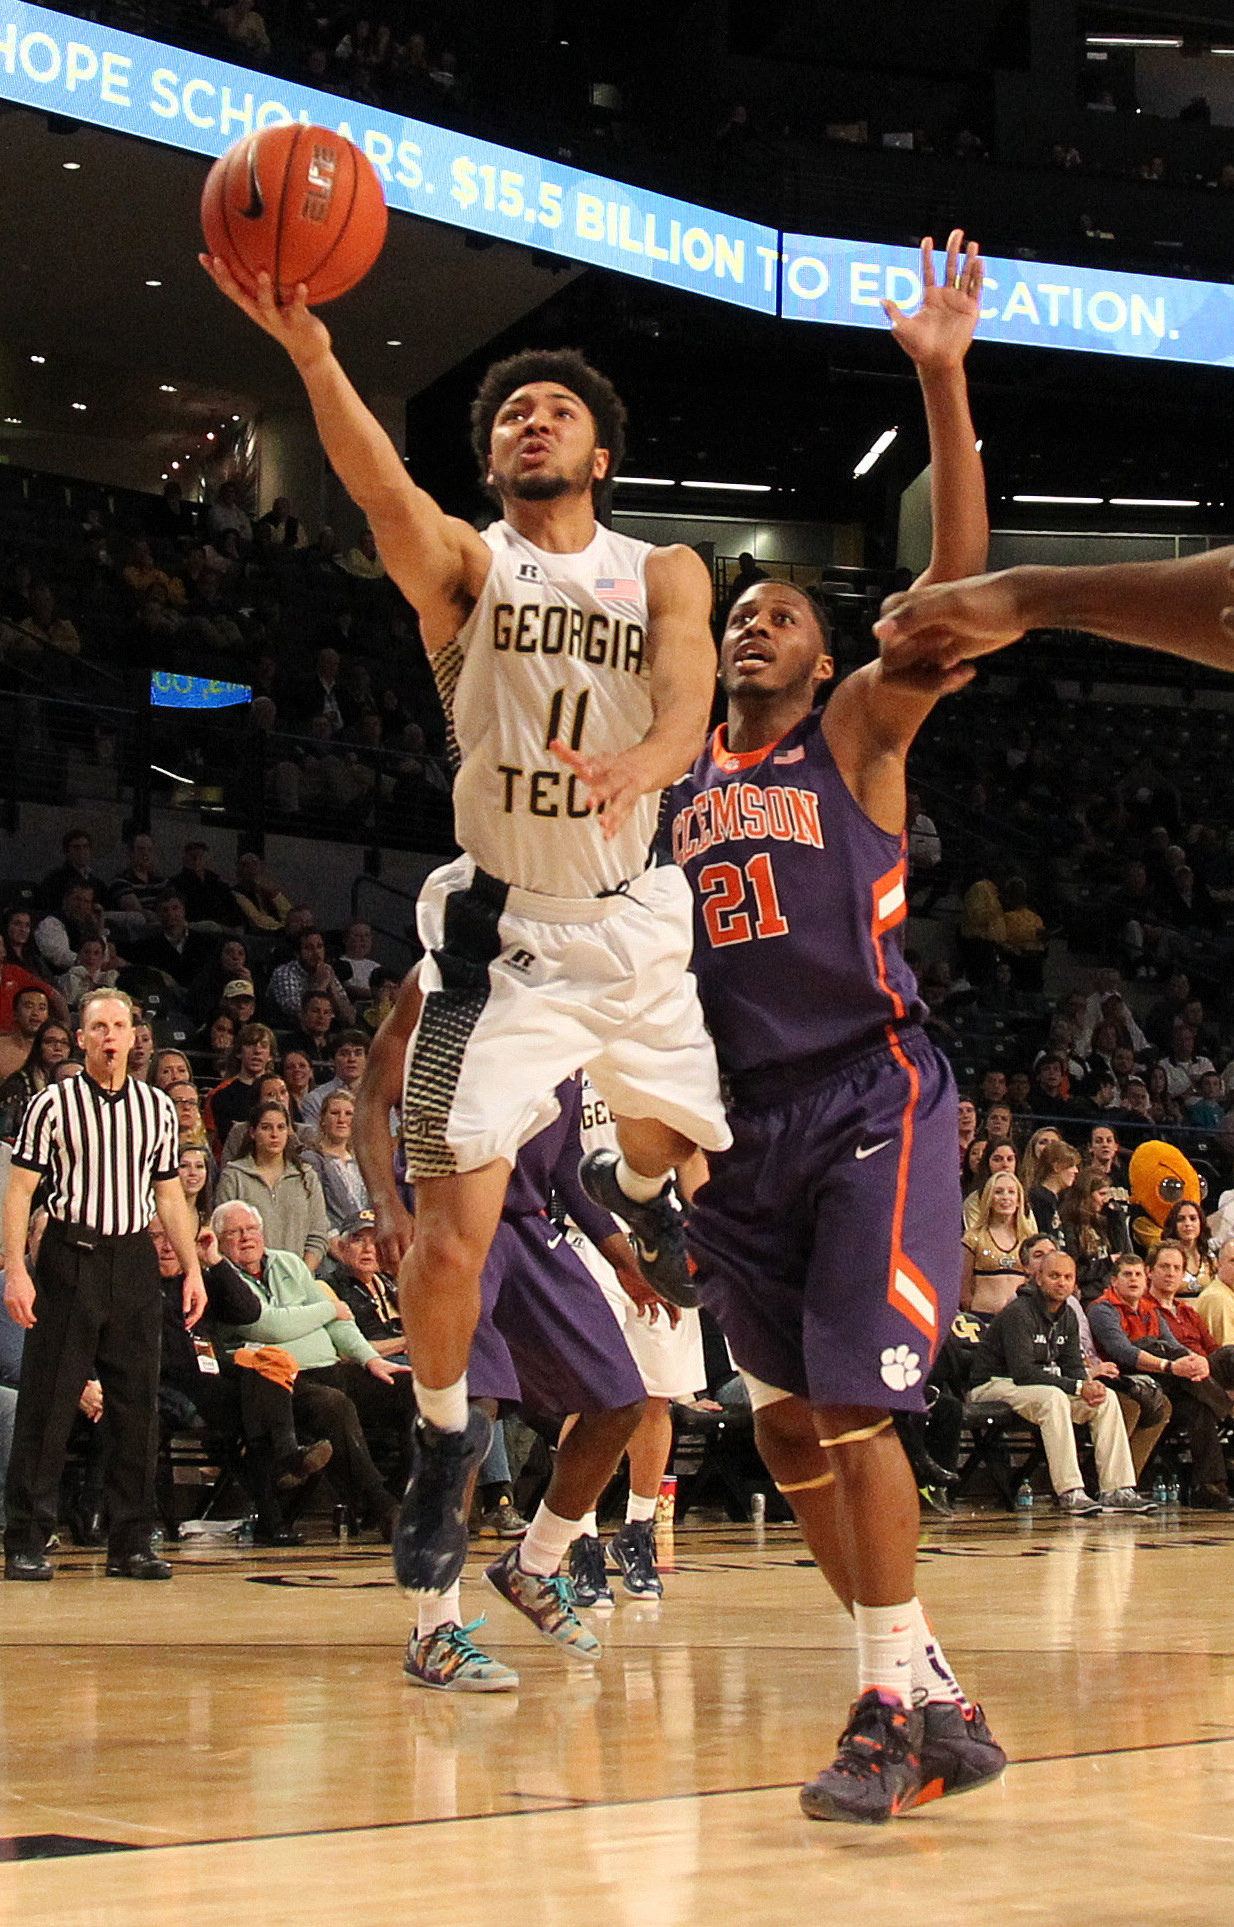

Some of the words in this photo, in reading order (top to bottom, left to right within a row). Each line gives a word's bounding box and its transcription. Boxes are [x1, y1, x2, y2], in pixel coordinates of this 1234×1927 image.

[450, 156, 562, 229] $15.5
[576, 192, 745, 283] BILLION
[757, 246, 829, 300] TO
[850, 261, 1180, 340] EDCATION.
[494, 603, 644, 676] GEORGIA
[545, 687, 590, 751] 11
[497, 765, 605, 818] TEC
[672, 782, 825, 867] CLEMSON
[698, 852, 790, 948] 21
